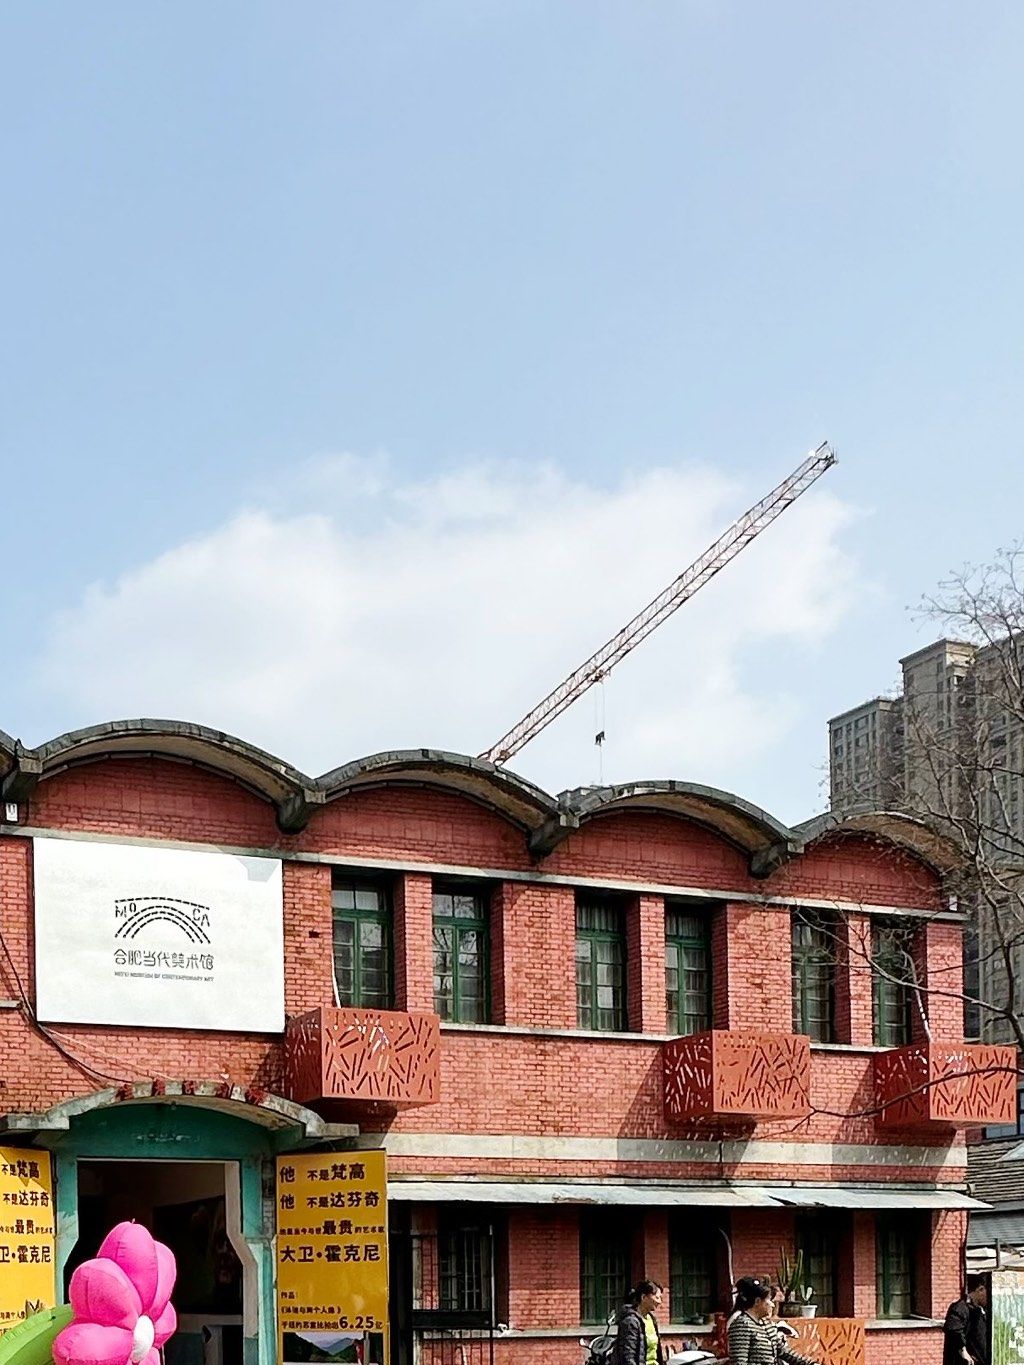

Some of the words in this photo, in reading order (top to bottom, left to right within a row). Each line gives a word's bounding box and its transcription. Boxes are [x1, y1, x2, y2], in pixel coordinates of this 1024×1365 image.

[113, 948, 215, 970] 合肥当代美术馆
[1, 1159, 40, 1179] 不是梵高
[280, 1165, 295, 1183] 他
[307, 1163, 366, 1181] 不是梵高
[2, 1189, 50, 1207] 不是达芬奇
[280, 1193, 295, 1210] 他
[306, 1190, 380, 1209] 不是达芬奇
